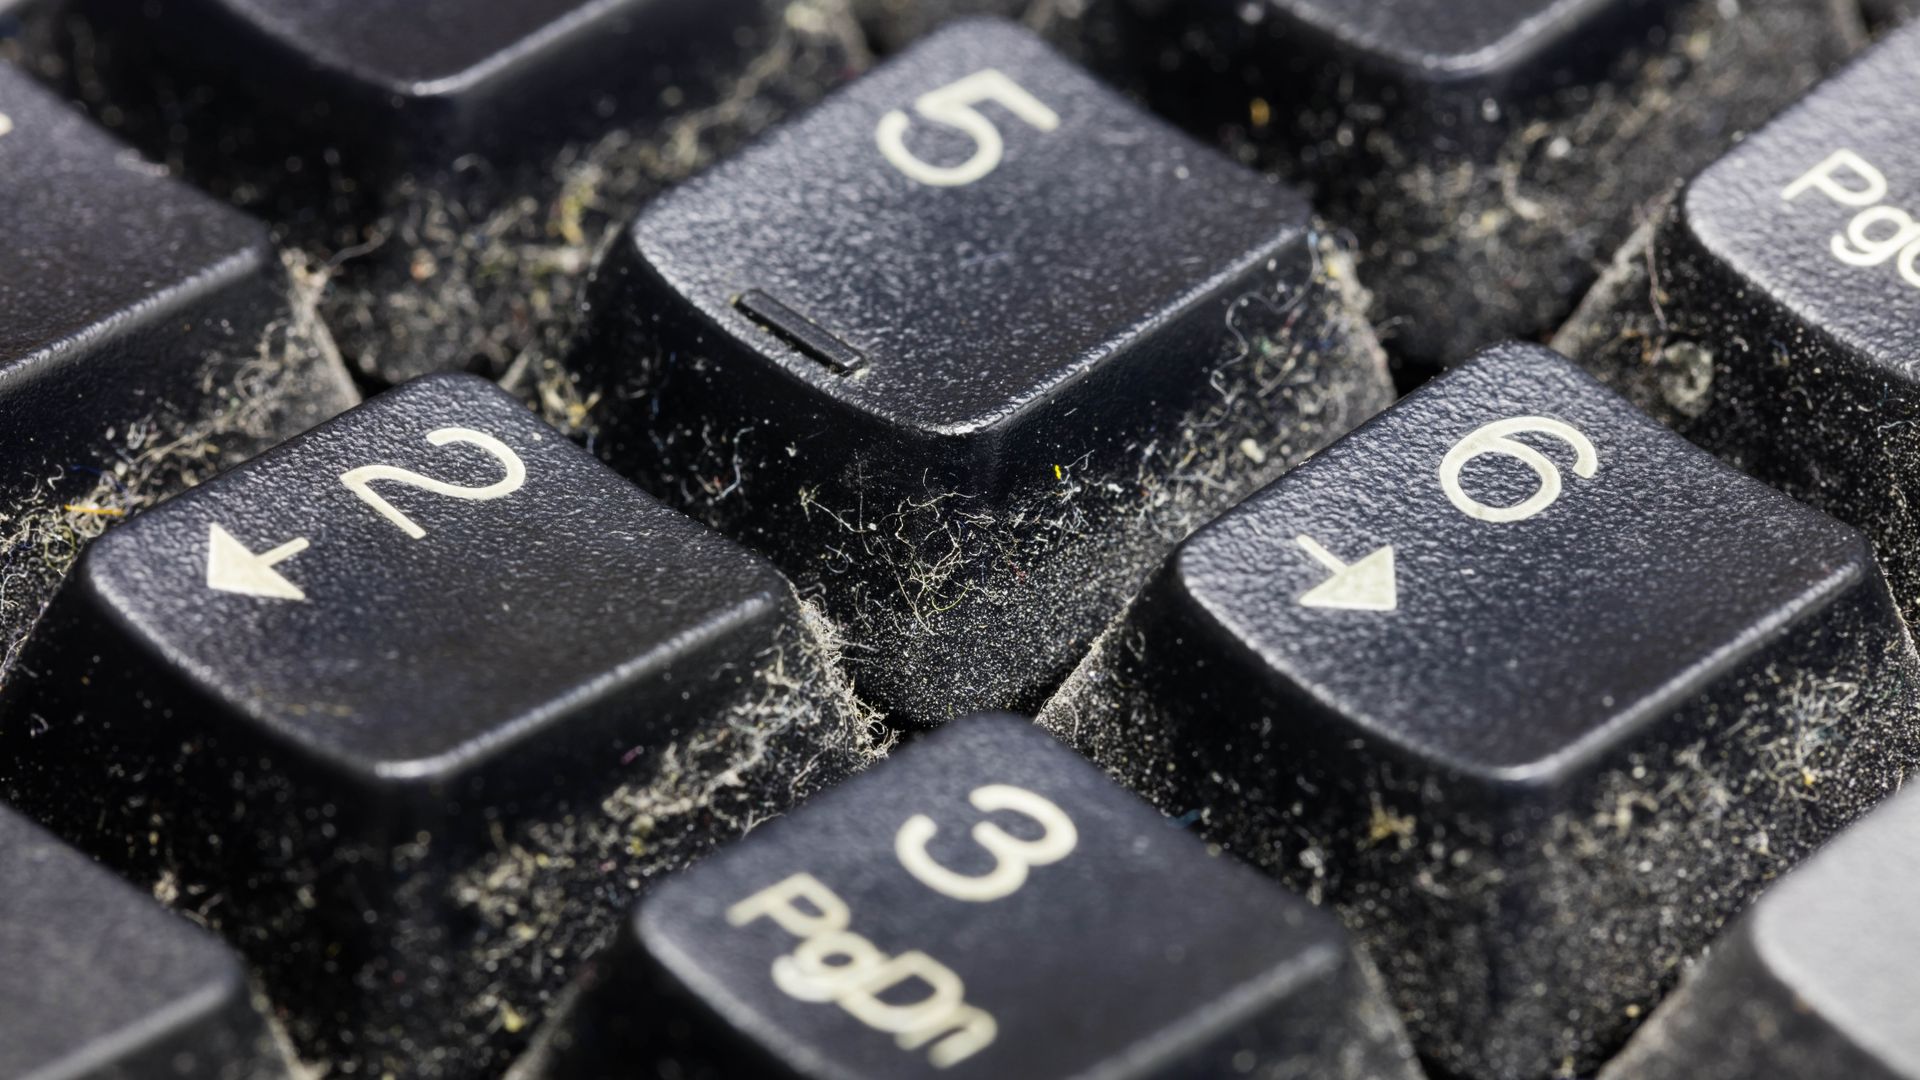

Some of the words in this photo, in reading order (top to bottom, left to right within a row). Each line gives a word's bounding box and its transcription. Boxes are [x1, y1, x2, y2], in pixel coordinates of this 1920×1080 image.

[877, 69, 1059, 187] 5
[341, 427, 527, 539] 2
[1439, 416, 1597, 523] 6
[894, 784, 1077, 901] 3
[726, 872, 997, 1067] PgDn
